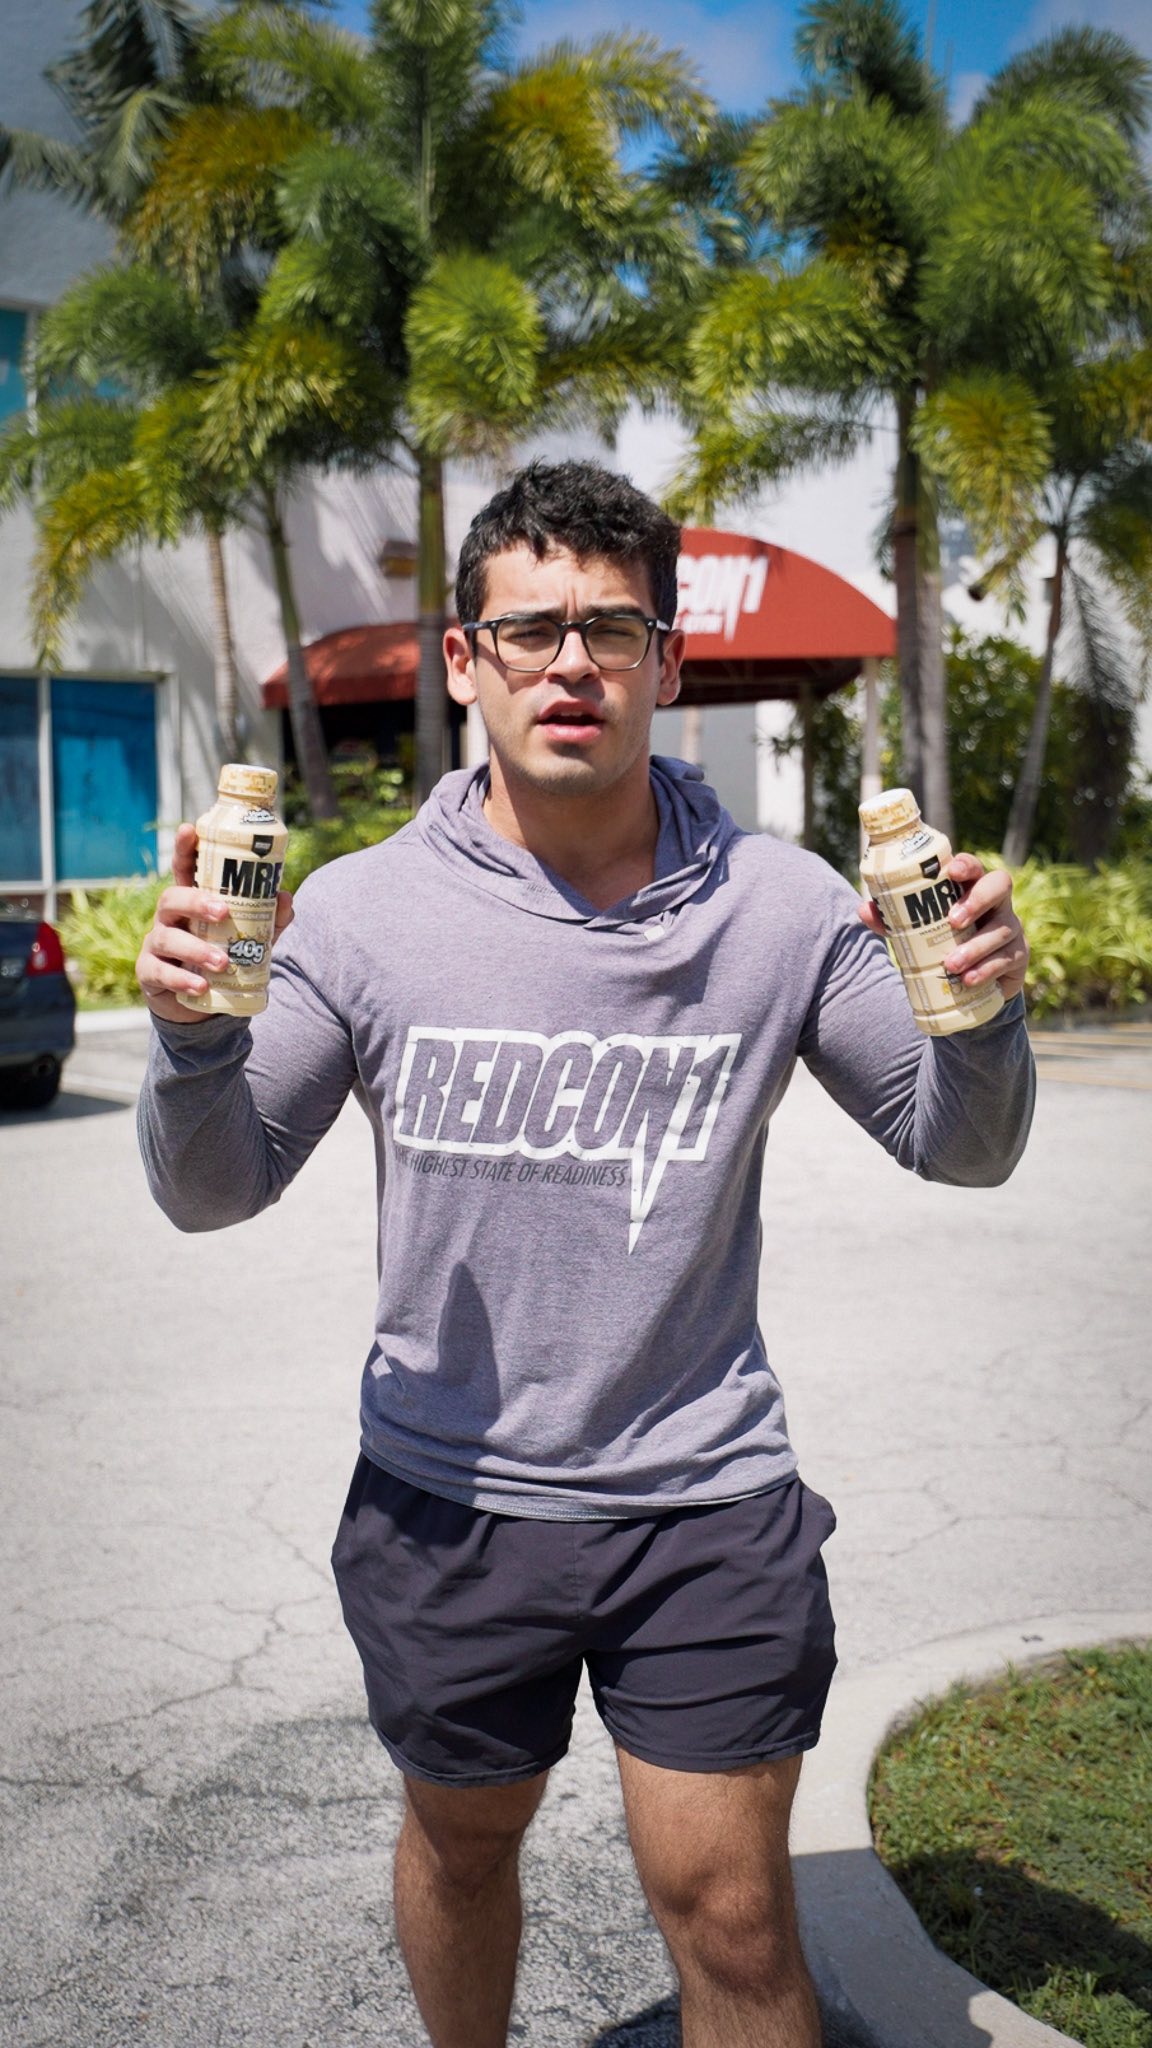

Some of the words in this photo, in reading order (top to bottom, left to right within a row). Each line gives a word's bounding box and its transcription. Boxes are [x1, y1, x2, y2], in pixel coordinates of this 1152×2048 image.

[903, 879, 964, 929] MR
[228, 939, 265, 965] 40g
[394, 1026, 742, 1210] REDCON1
[410, 1153, 468, 1178] HIGHEST
[470, 1159, 513, 1182] STATE
[517, 1162, 541, 1183] OF
[542, 1163, 628, 1188] READINESS
